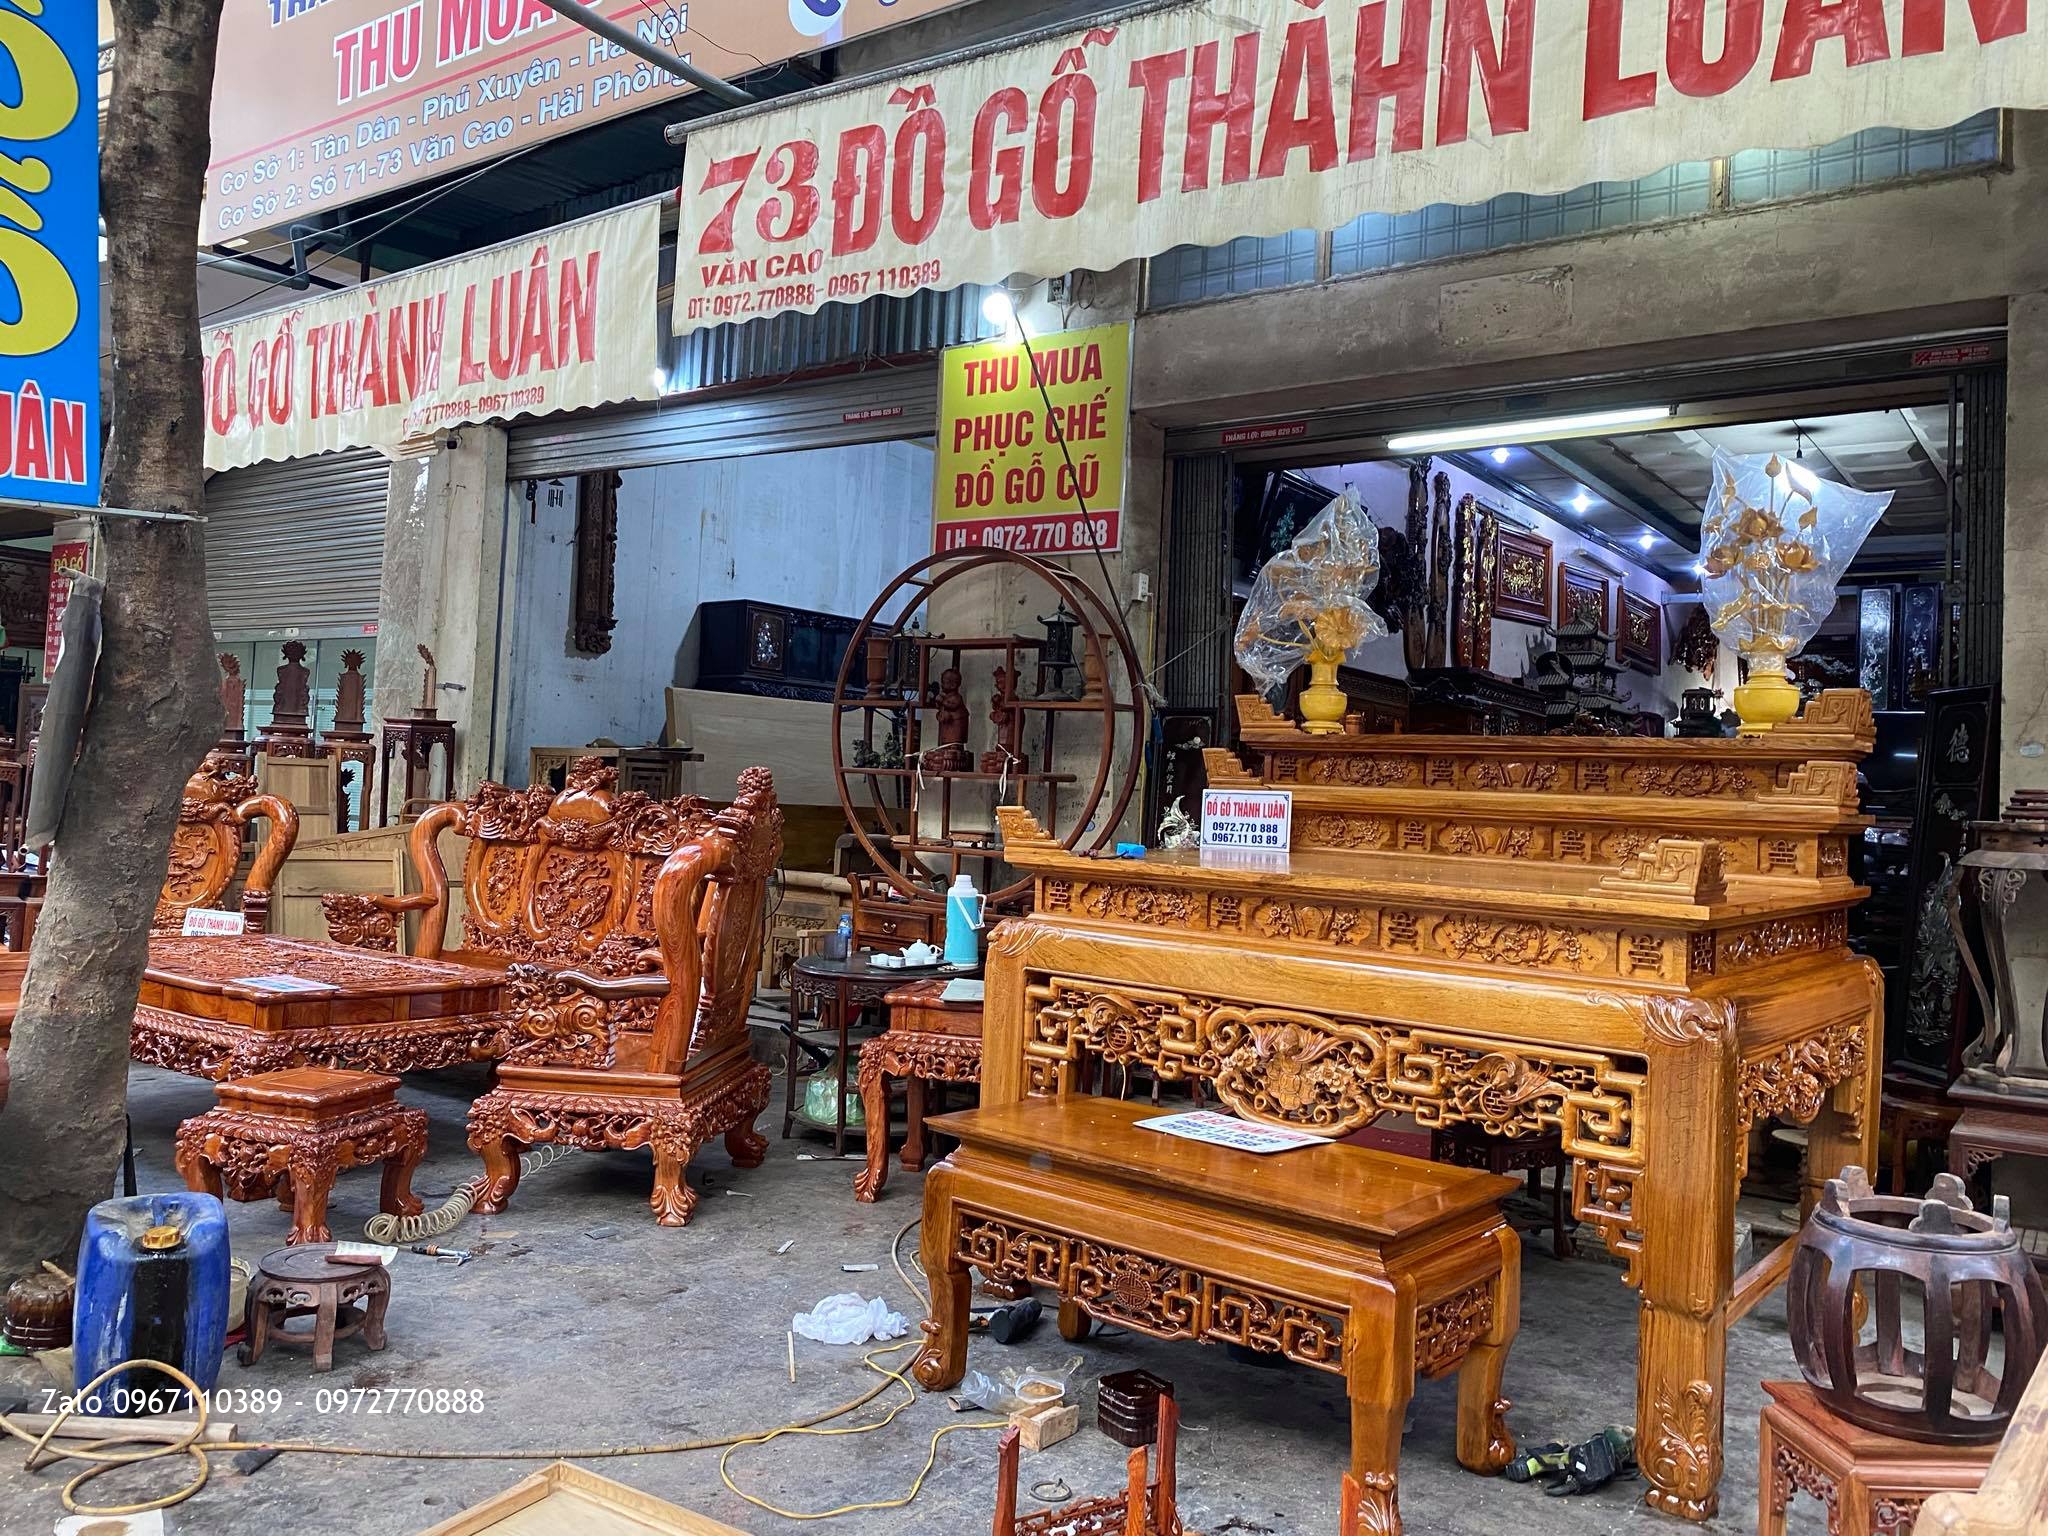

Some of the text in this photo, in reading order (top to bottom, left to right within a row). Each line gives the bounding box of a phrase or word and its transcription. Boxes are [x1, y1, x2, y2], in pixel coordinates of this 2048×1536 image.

[333, 0, 423, 106] THU
[220, 171, 248, 195] Cơ
[253, 155, 281, 184] Sở
[288, 149, 304, 172] 1:
[312, 133, 349, 164] Tân
[356, 116, 400, 148] Dân
[422, 83, 470, 126] Phú
[477, 56, 560, 106] Xuyên
[637, 3, 688, 46] Nội
[218, 207, 246, 231] Cơ
[251, 191, 280, 219] Sở
[284, 184, 302, 209] 2:
[309, 164, 337, 200] Số
[344, 147, 402, 189] 71-73
[409, 134, 455, 168] Văn
[463, 115, 514, 149] Cao
[538, 83, 584, 125] Hải
[698, 139, 822, 255] 73
[832, 83, 947, 257] ĐỒ
[968, 26, 1119, 231] GỖ
[701, 249, 824, 288] VĂN CAO
[877, 259, 941, 291] 110389
[248, 310, 305, 431] GỖ
[306, 290, 448, 420] THÀNH
[458, 245, 600, 386] LUÂN
[964, 343, 1102, 397] THU MUA
[953, 386, 1111, 457] PHỤC CHẾ
[955, 451, 1099, 508] ĐỒ GỖ CŨ
[1213, 822, 1277, 833] 0972.770 888
[1234, 800, 1260, 818] THÀNH
[1263, 800, 1285, 818] LUÂN
[1212, 833, 1277, 844] 0967.11 03 89
